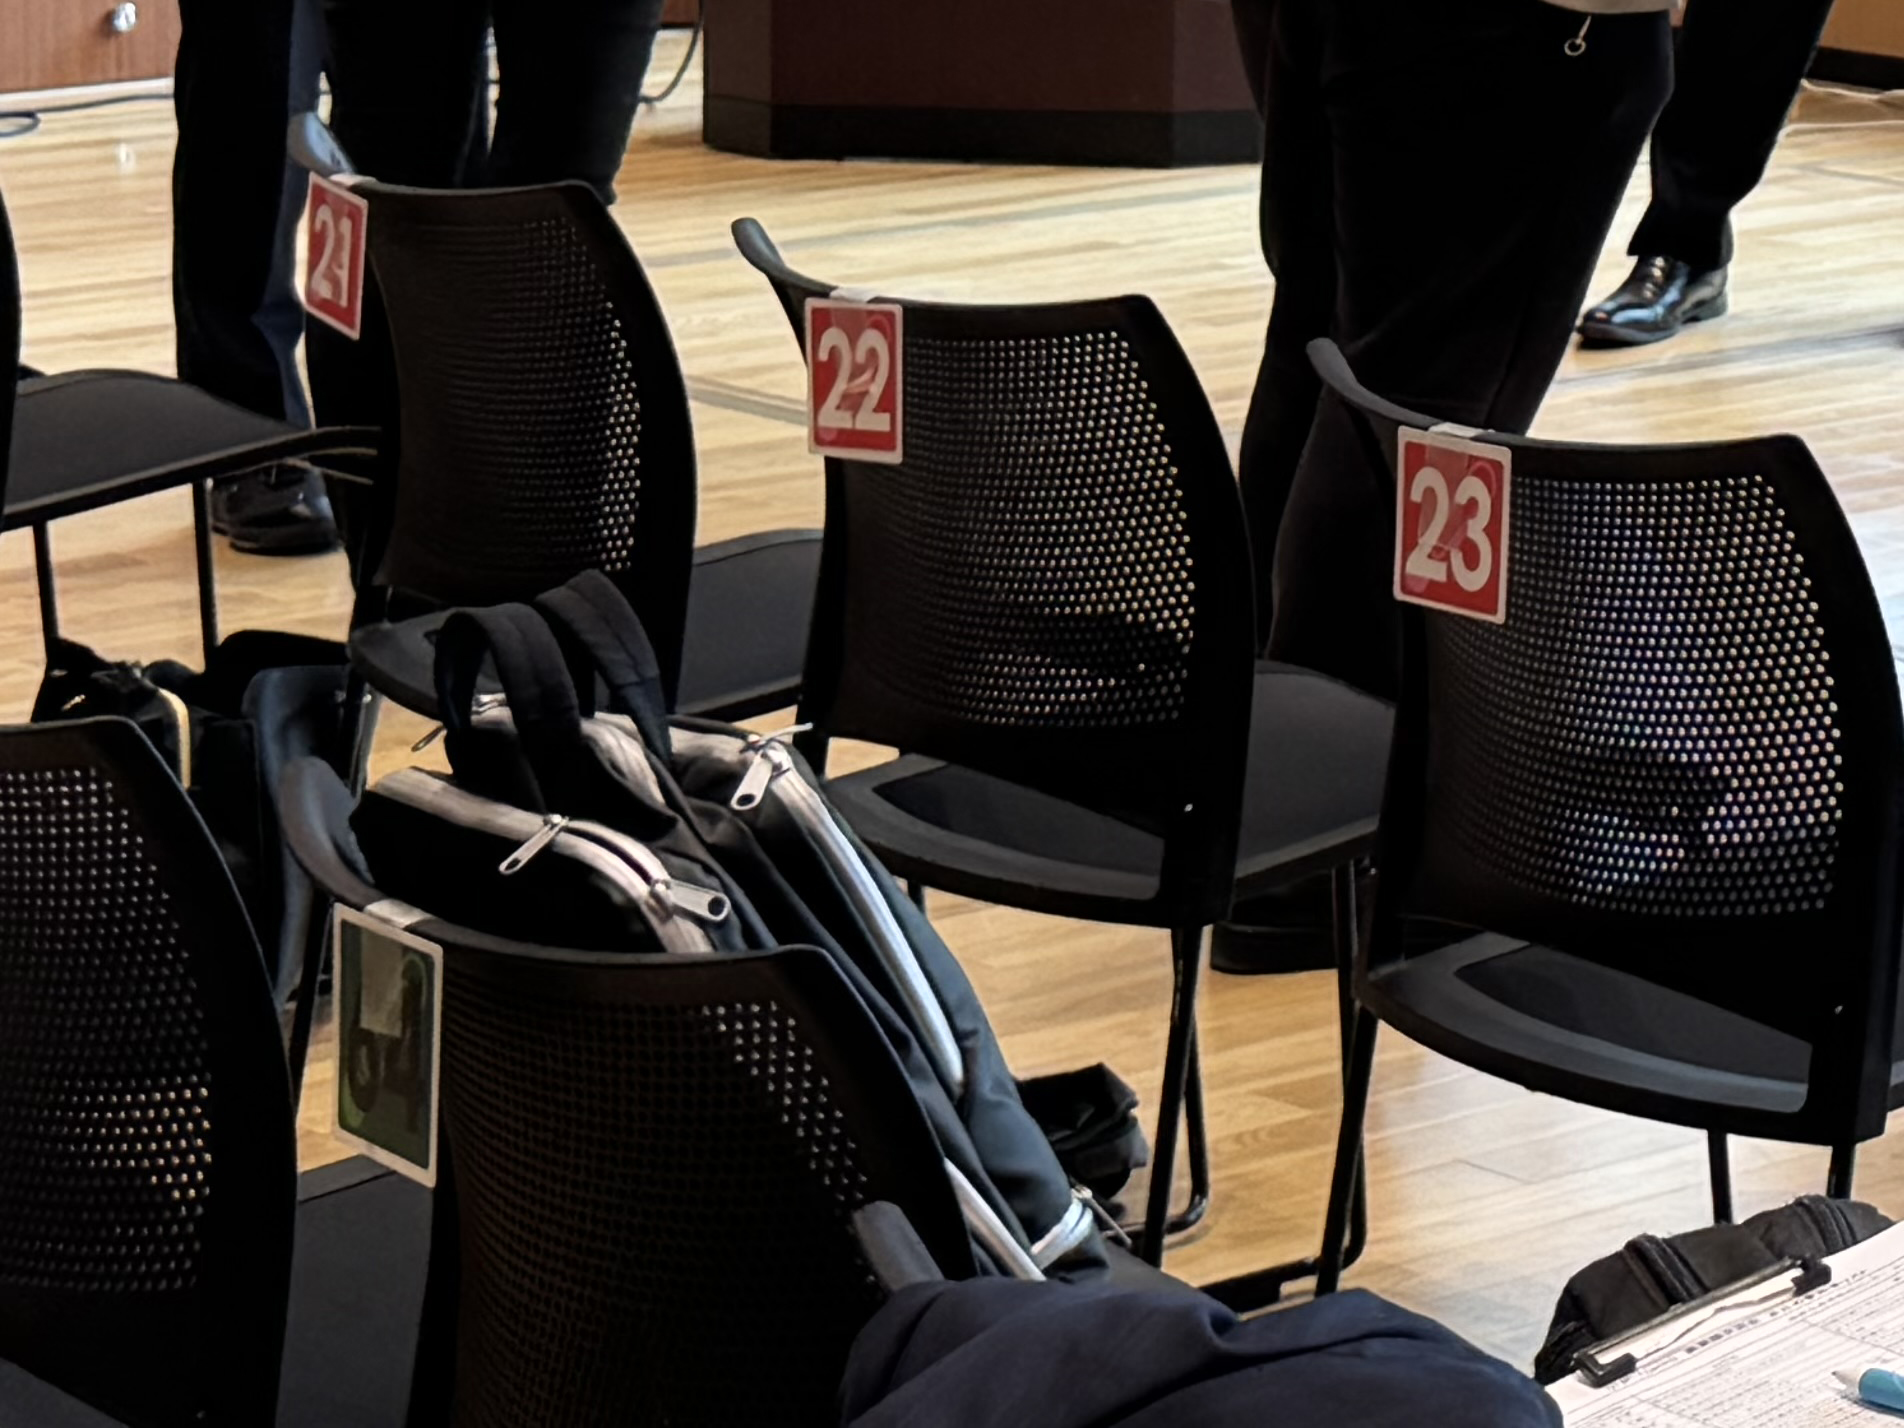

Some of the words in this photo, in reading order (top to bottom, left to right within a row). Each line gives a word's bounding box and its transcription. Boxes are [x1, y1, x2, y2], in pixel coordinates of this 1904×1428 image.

[311, 203, 352, 308] 21
[817, 327, 891, 432] 22
[1406, 466, 1492, 592] 23
